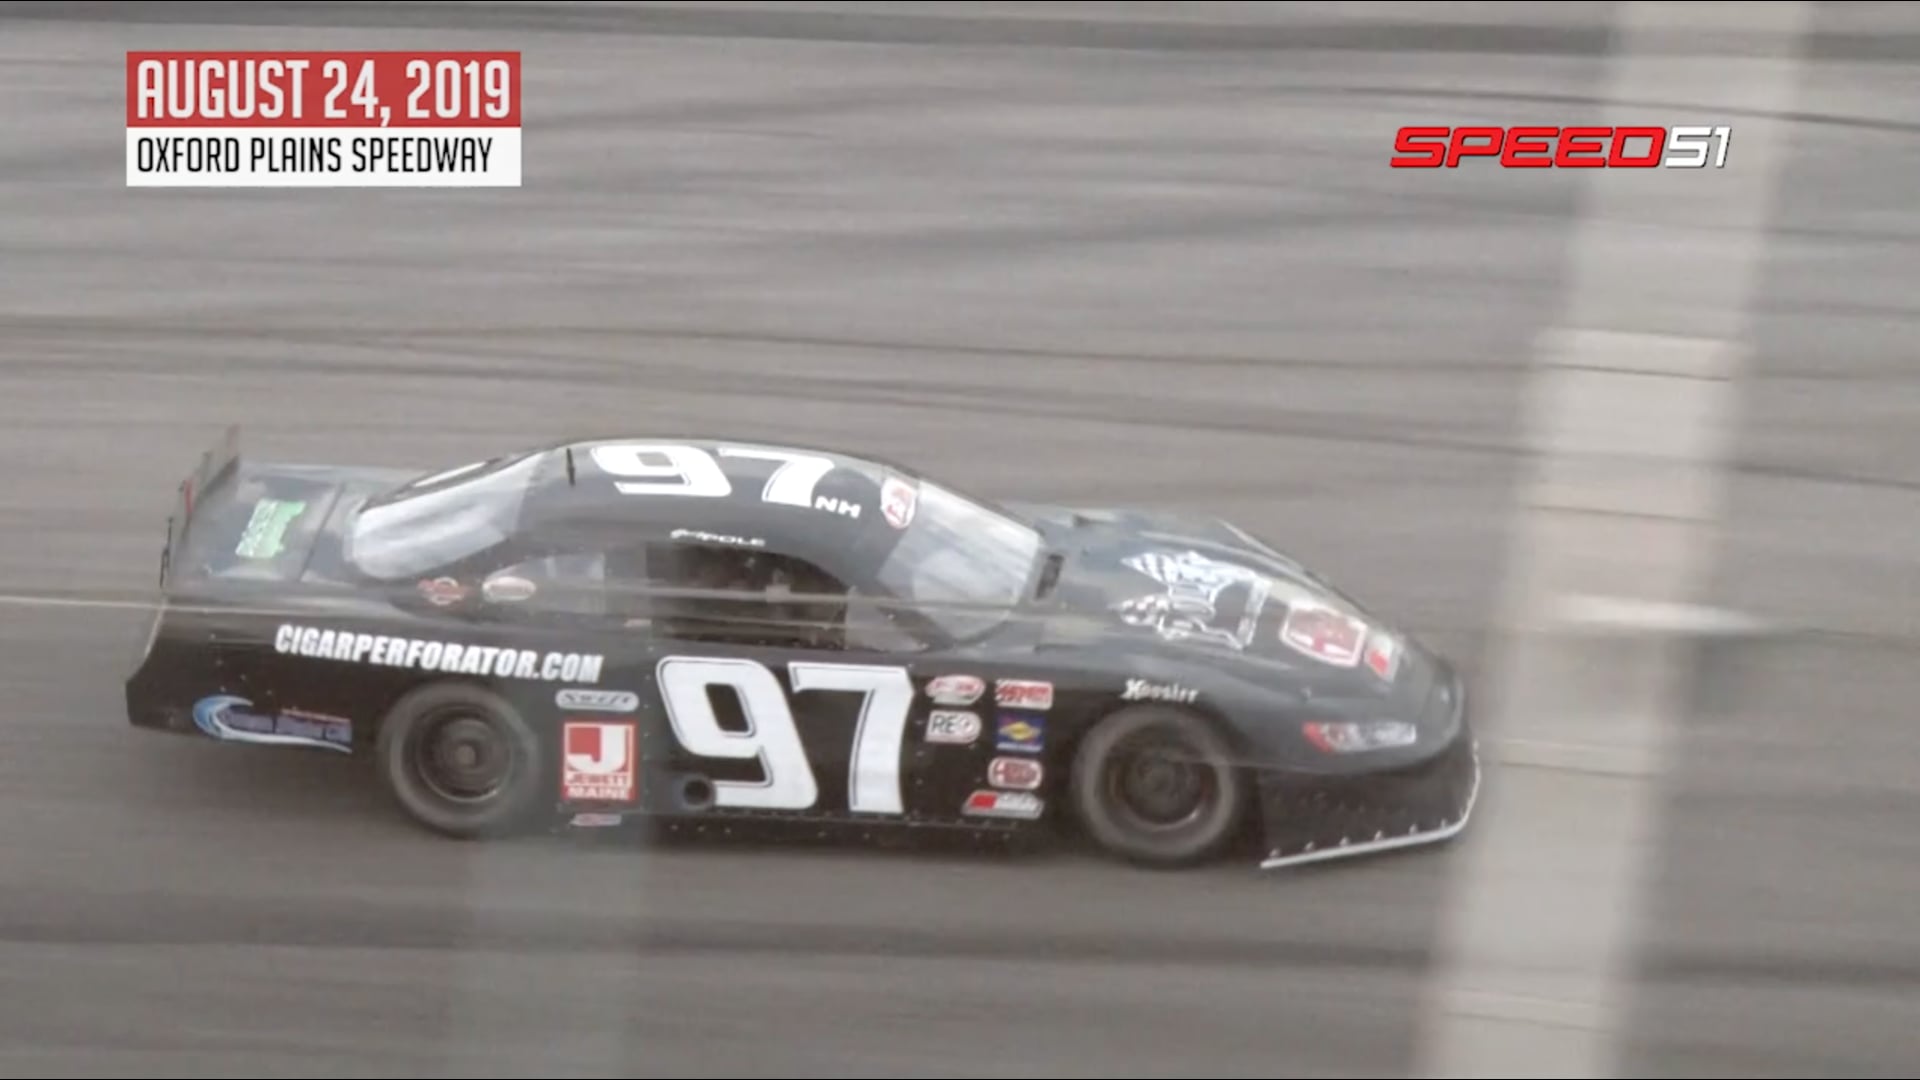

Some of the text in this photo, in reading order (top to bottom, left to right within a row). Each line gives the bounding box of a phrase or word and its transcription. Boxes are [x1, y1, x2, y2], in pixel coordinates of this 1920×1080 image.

[590, 445, 835, 507] 97
[815, 496, 861, 518] NH
[275, 624, 603, 684] CIGARPERFORATOR.COM
[656, 655, 914, 813] 97
